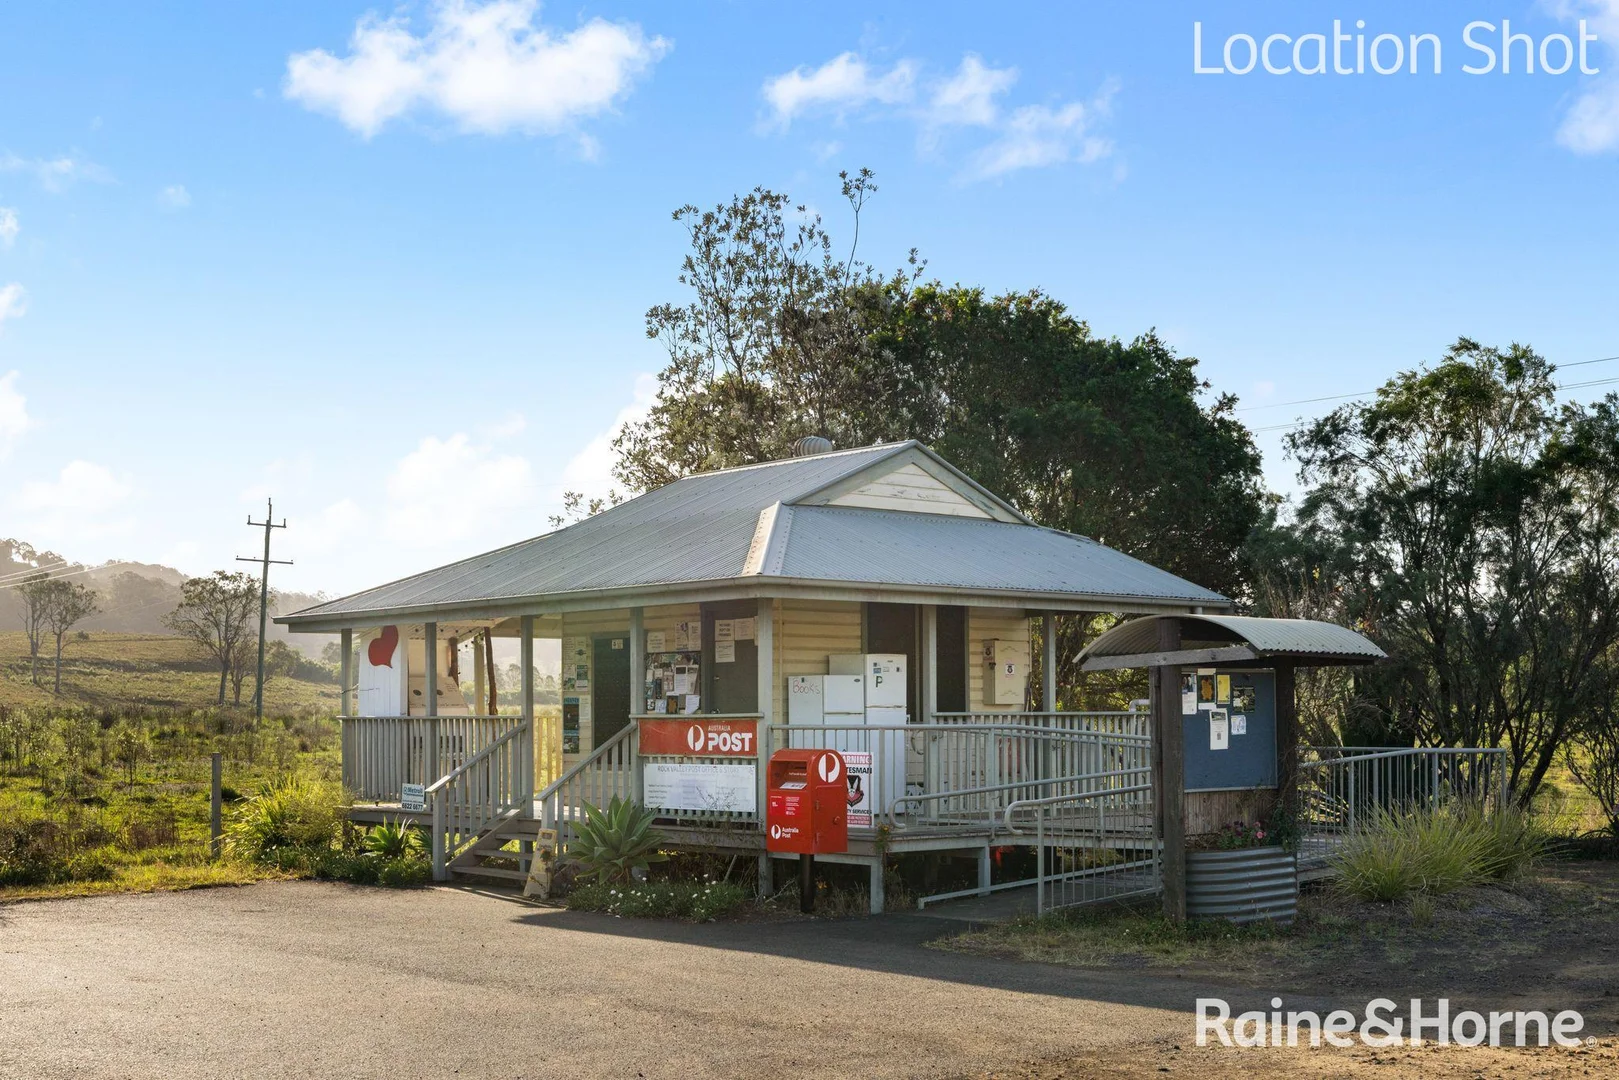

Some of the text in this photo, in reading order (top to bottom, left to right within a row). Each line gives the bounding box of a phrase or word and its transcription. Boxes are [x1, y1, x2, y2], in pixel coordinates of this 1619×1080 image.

[875, 676, 883, 688] P
[708, 732, 753, 752] POST
[843, 755, 871, 764] ARNING
[657, 765, 670, 773] ROCK
[670, 765, 687, 773] VALLEY
[687, 765, 700, 773] POST
[701, 765, 719, 774] OFFICE
[723, 766, 740, 774] STORE
[846, 766, 872, 774] TESMAN
